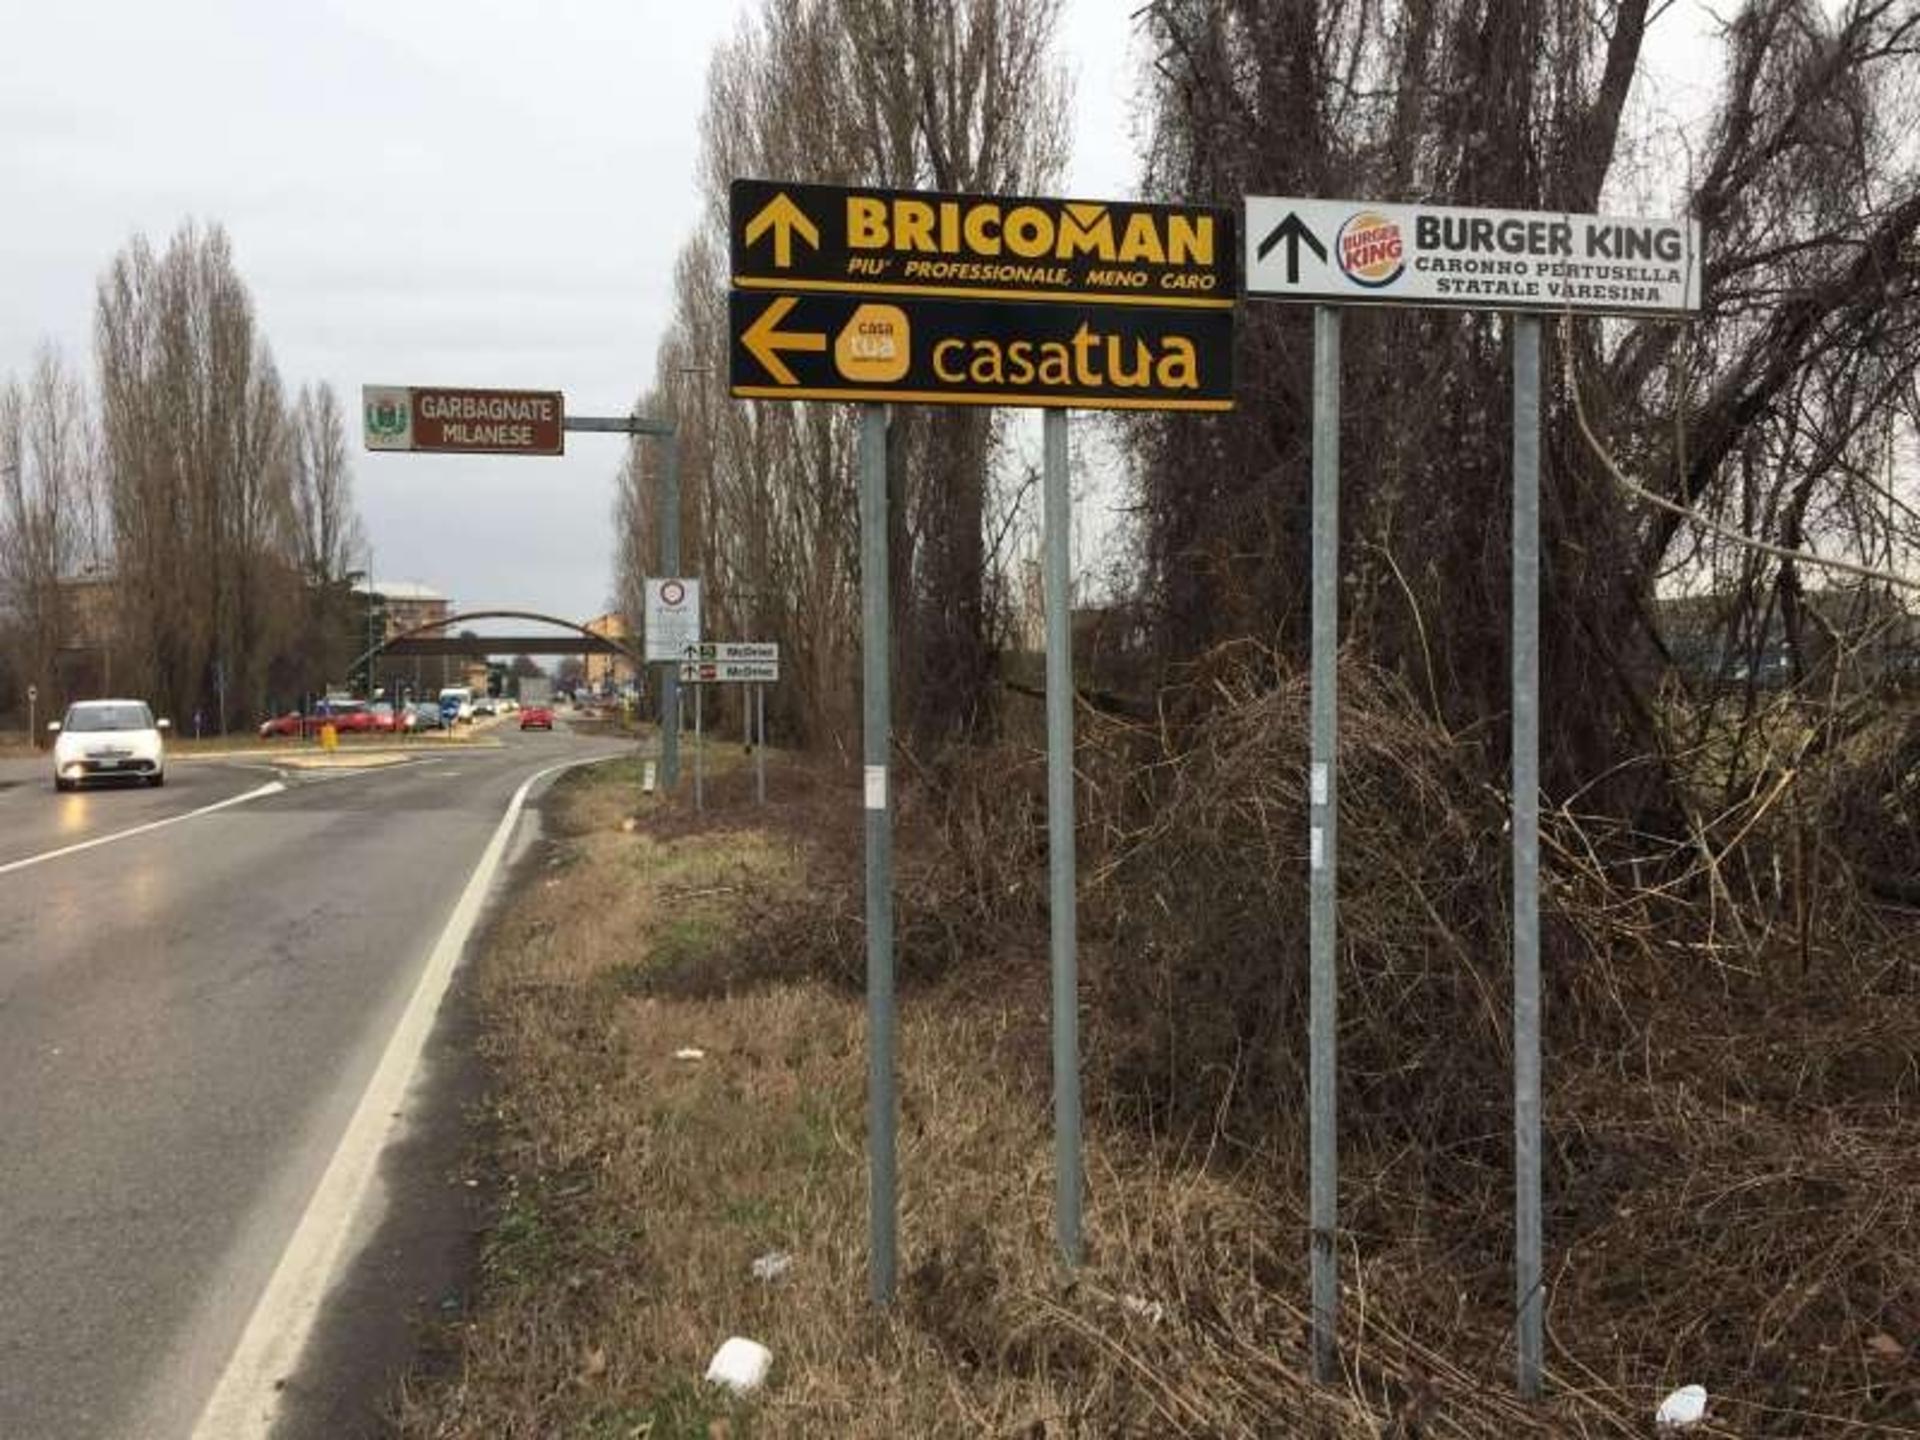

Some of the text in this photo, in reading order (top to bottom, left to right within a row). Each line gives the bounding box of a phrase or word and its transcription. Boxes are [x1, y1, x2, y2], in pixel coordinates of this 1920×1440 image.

[846, 196, 1214, 265] BRICOMAN
[1343, 225, 1400, 250] BURGER
[1415, 214, 1682, 263] BURGER KING
[1345, 239, 1403, 270] KING
[1086, 269, 1149, 288] MENO
[1160, 272, 1216, 290] CARO
[1535, 261, 1682, 284] PERTUSELLA
[1436, 277, 1661, 301] STATALE VARESINA
[858, 322, 894, 336] casa
[931, 320, 1200, 390] casatua
[420, 395, 553, 421] GARBAGNATE
[442, 423, 535, 445] MILANESE
